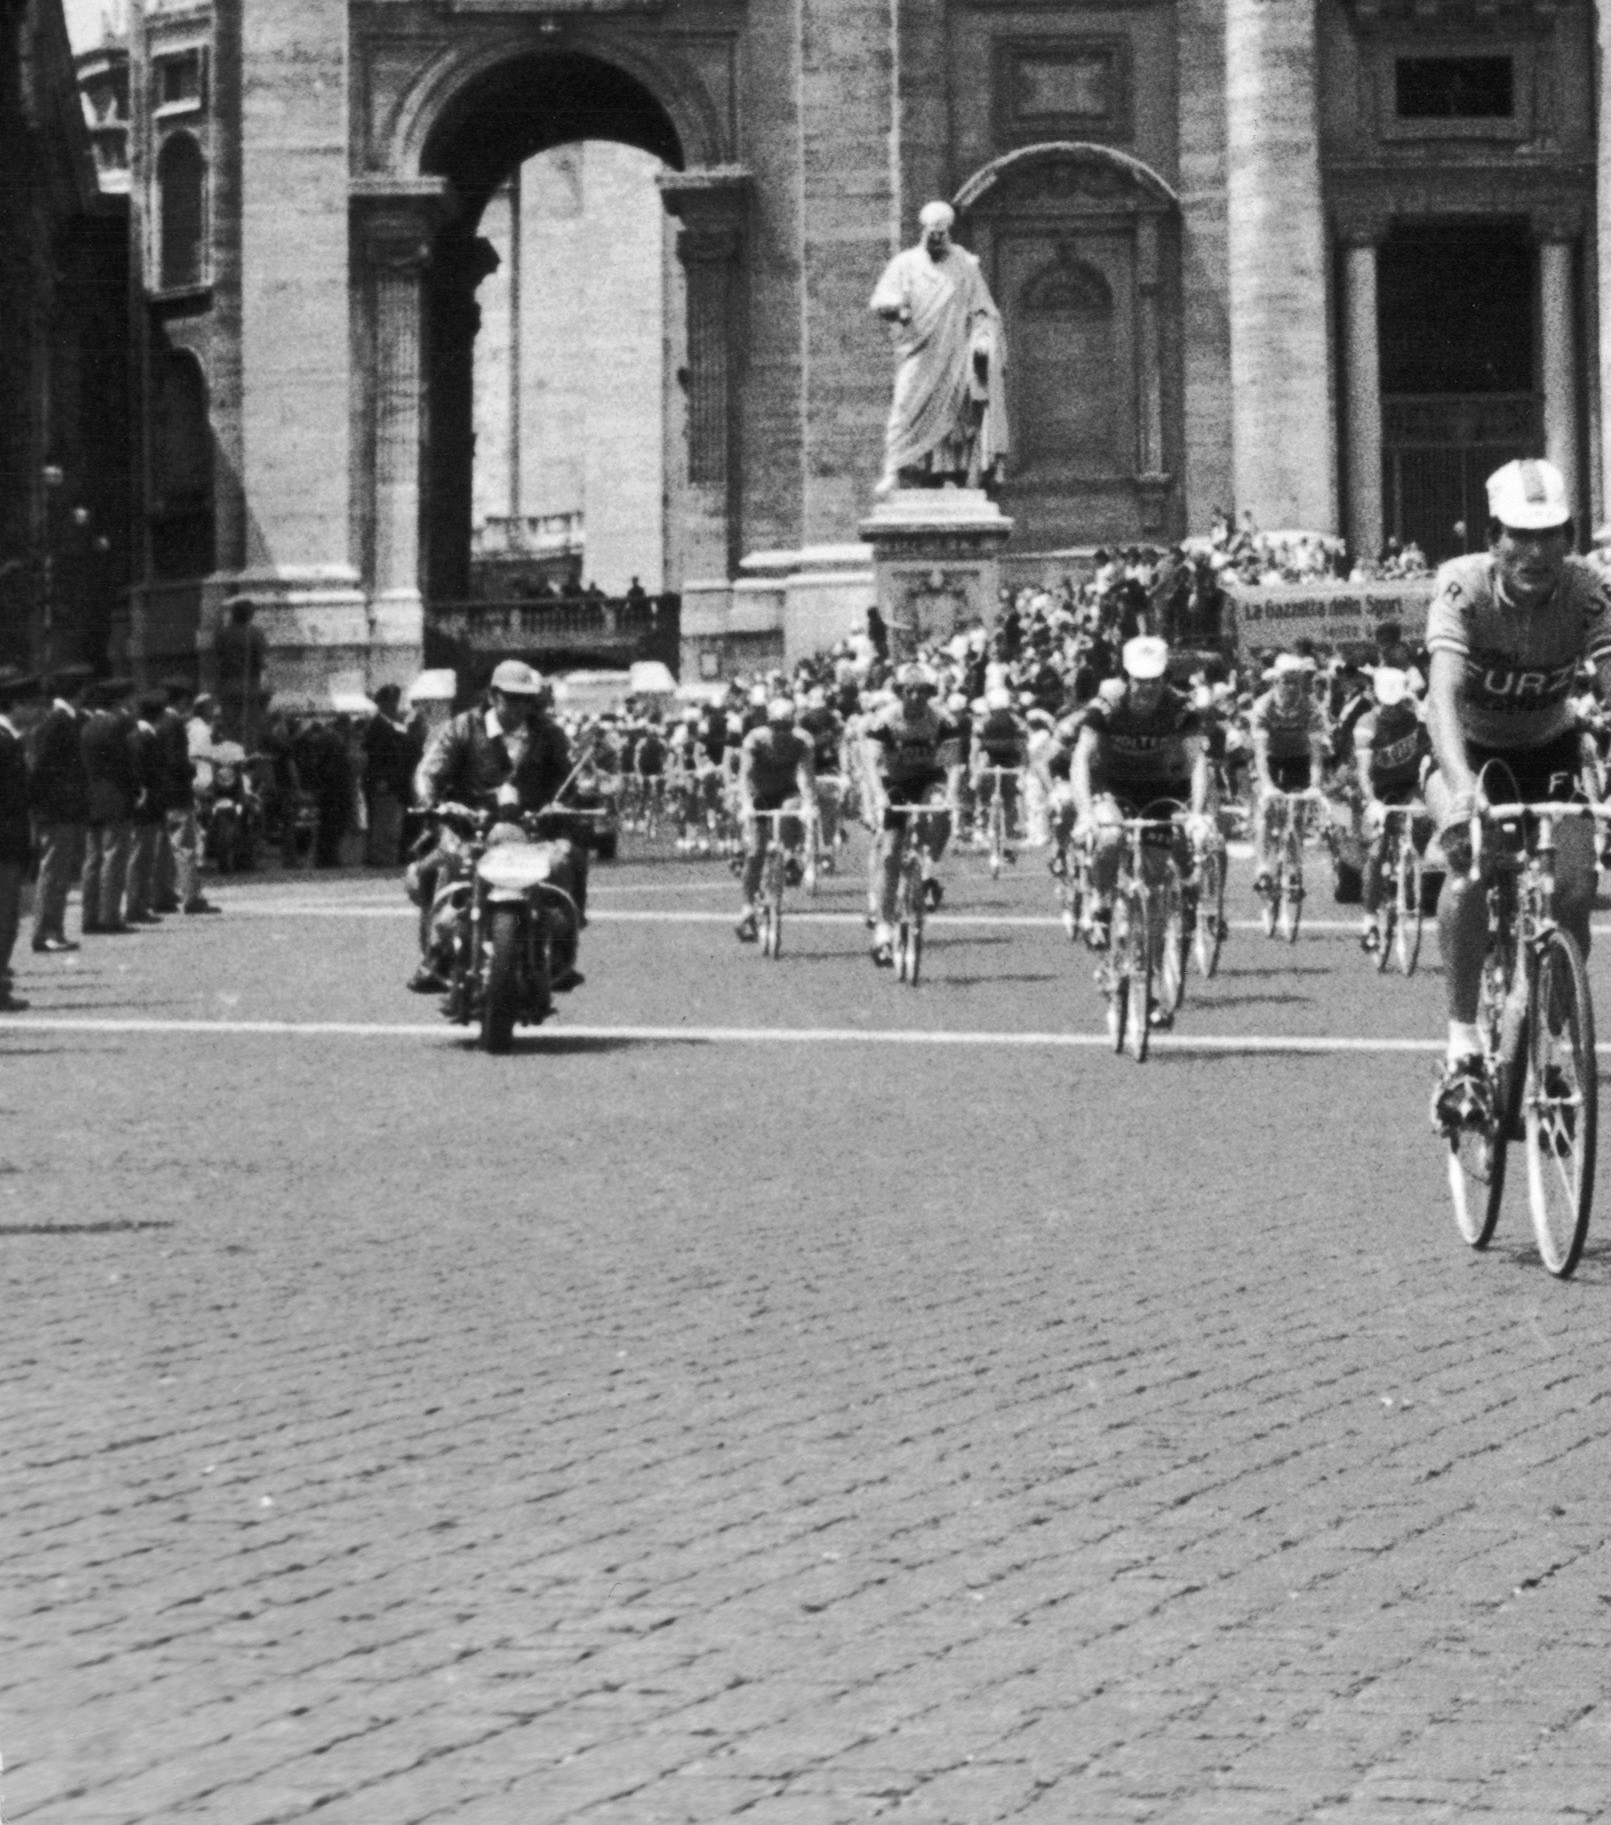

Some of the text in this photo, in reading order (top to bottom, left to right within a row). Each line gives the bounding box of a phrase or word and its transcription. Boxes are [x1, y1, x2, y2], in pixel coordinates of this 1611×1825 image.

[1245, 602, 1262, 621] La
[1265, 598, 1325, 620] Gazzetta
[1365, 593, 1402, 620] Sport
